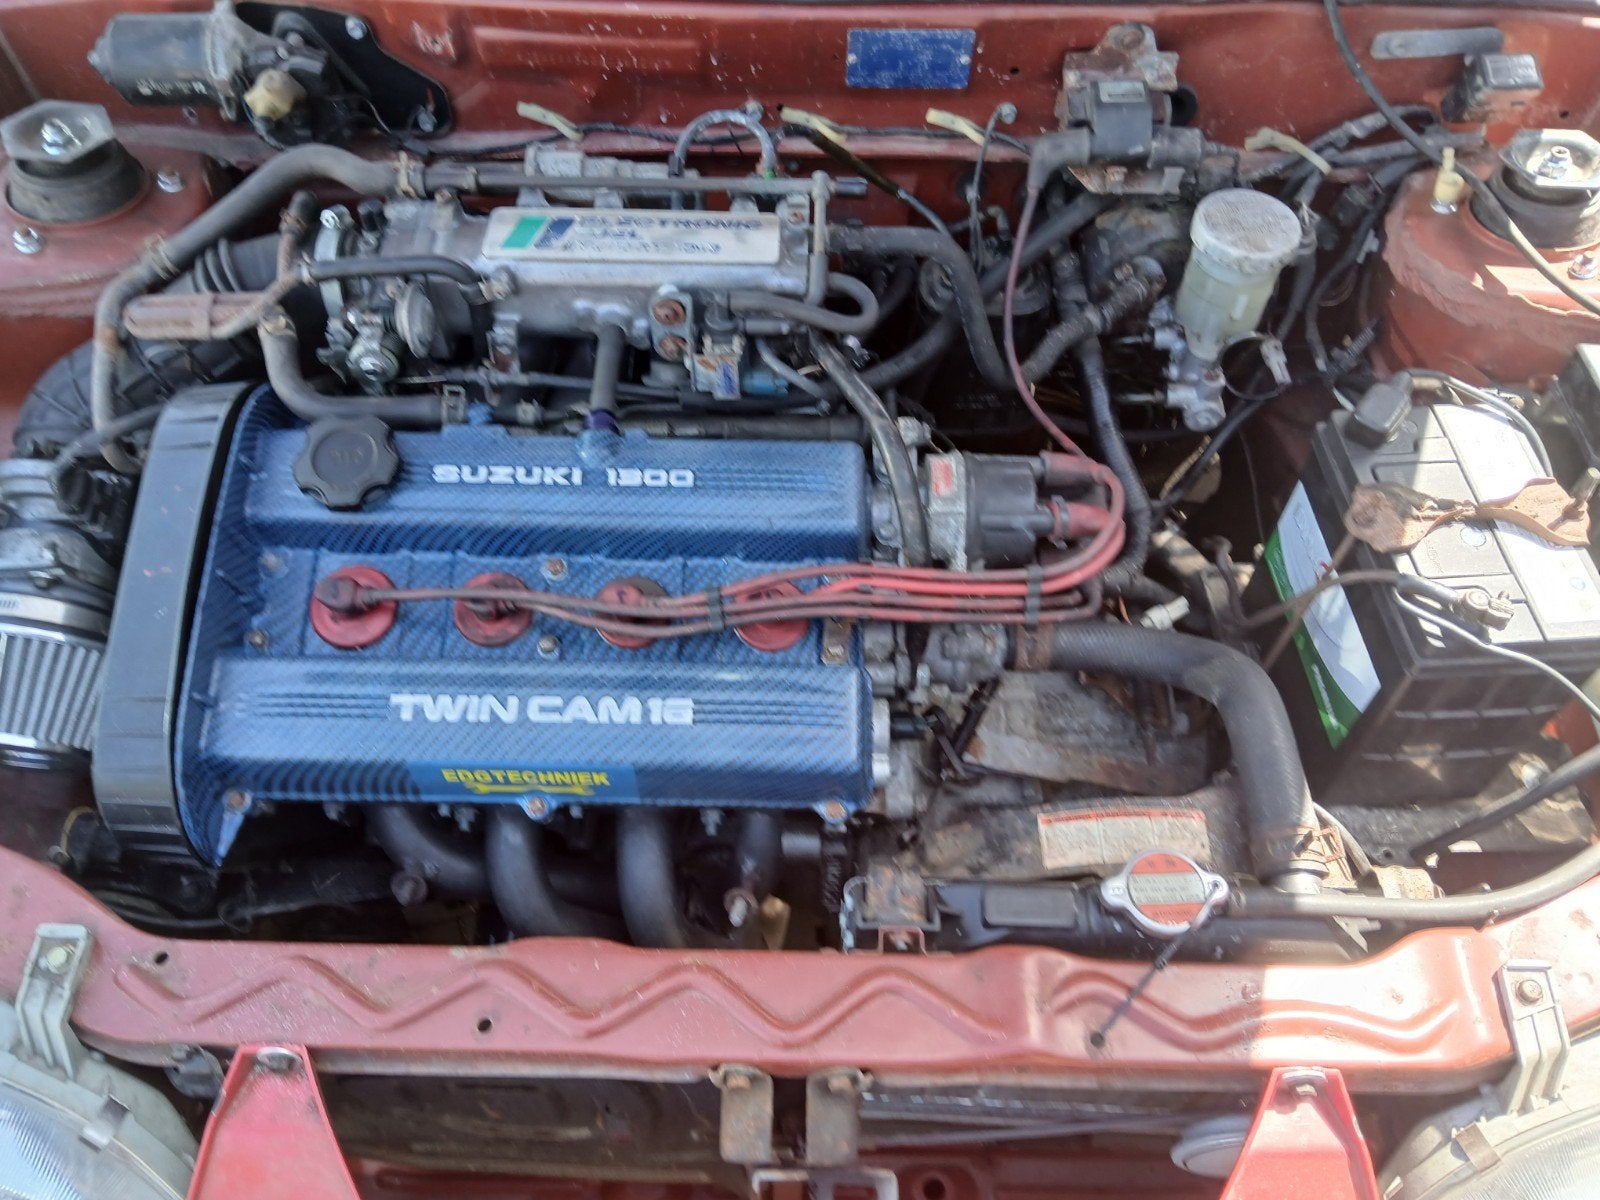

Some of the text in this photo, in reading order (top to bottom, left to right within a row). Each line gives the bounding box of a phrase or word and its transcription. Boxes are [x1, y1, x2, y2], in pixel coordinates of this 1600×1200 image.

[432, 464, 695, 488] SUZUKI 1300
[390, 693, 695, 726] TWIN CAM 16
